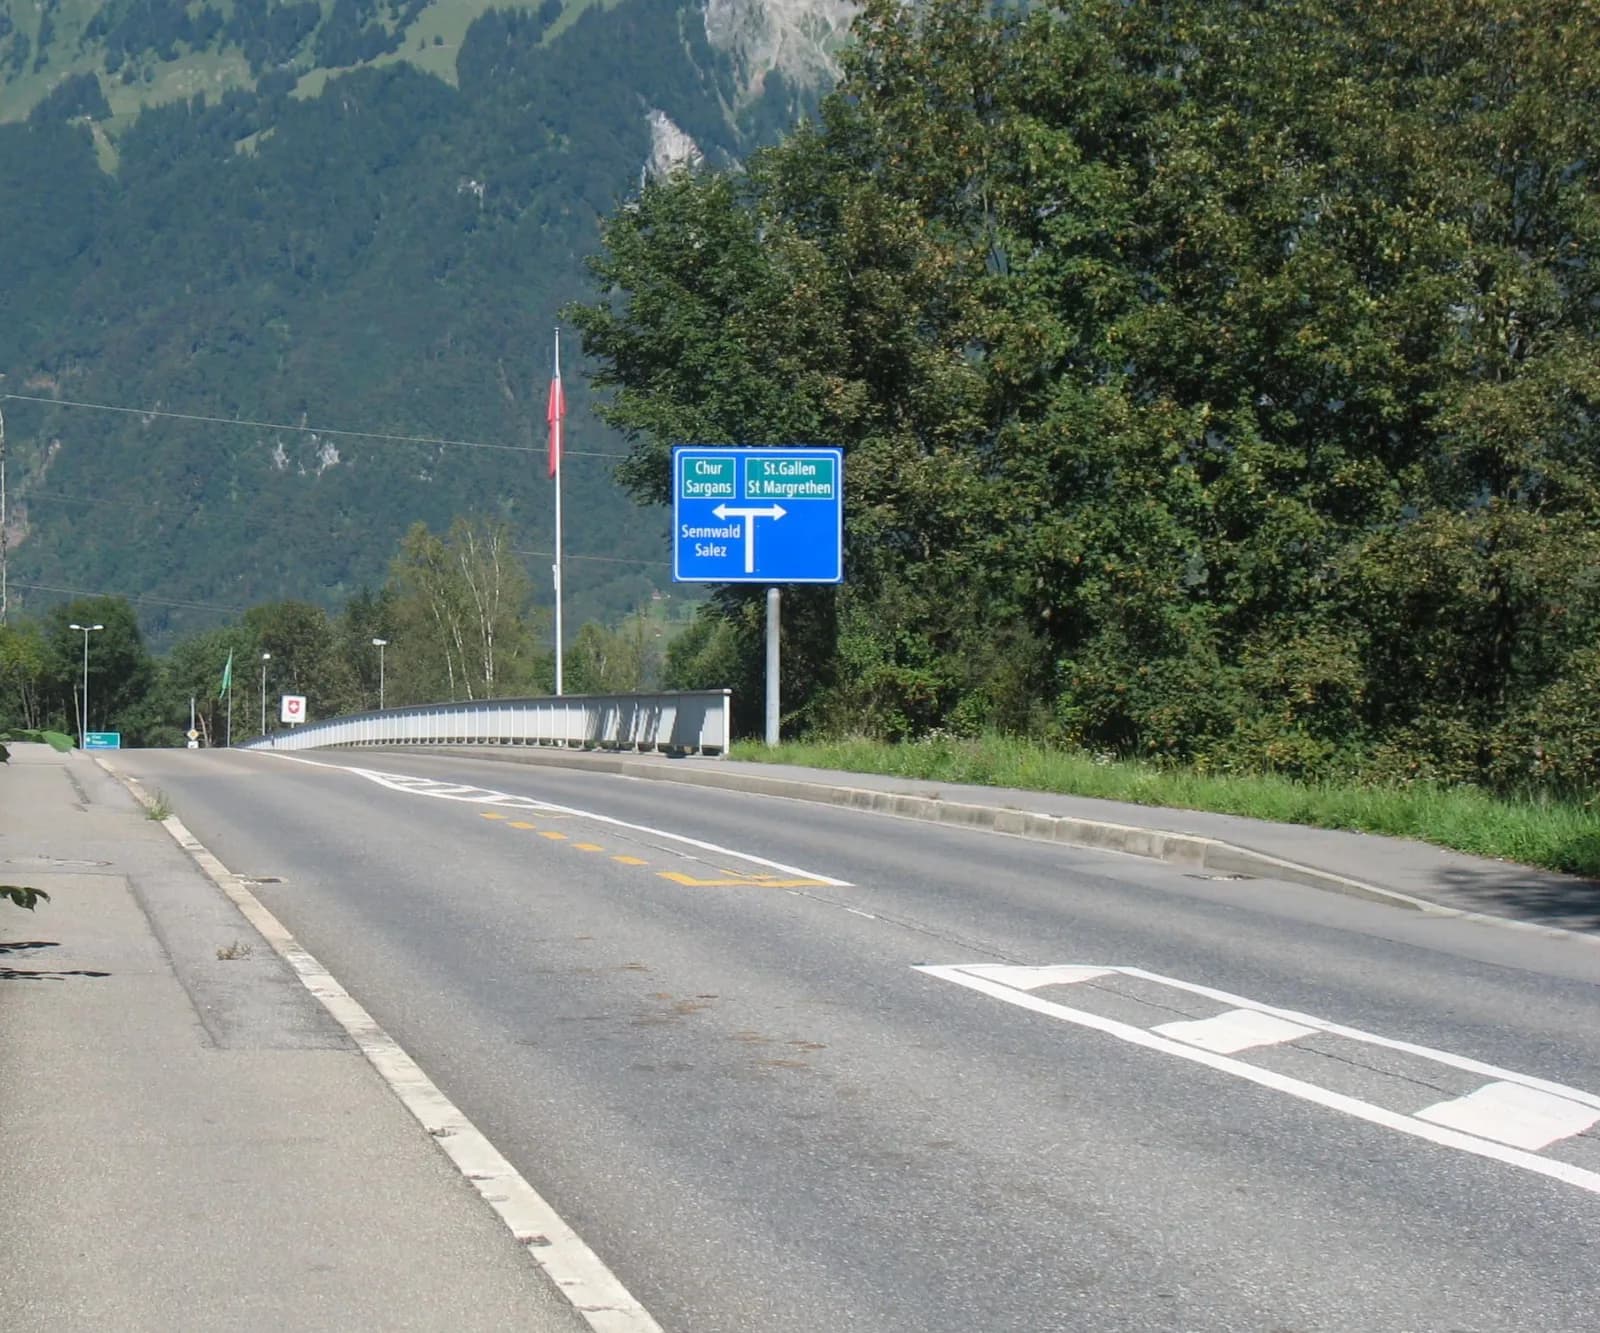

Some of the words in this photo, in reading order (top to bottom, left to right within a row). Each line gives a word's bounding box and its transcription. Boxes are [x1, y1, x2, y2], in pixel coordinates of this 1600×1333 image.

[695, 461, 723, 475] Chur
[763, 461, 816, 476] St.Gallen
[686, 480, 732, 497] Sargans
[764, 480, 831, 497] Margrethen
[682, 524, 741, 539] Sennwald
[695, 543, 727, 557] Salez
